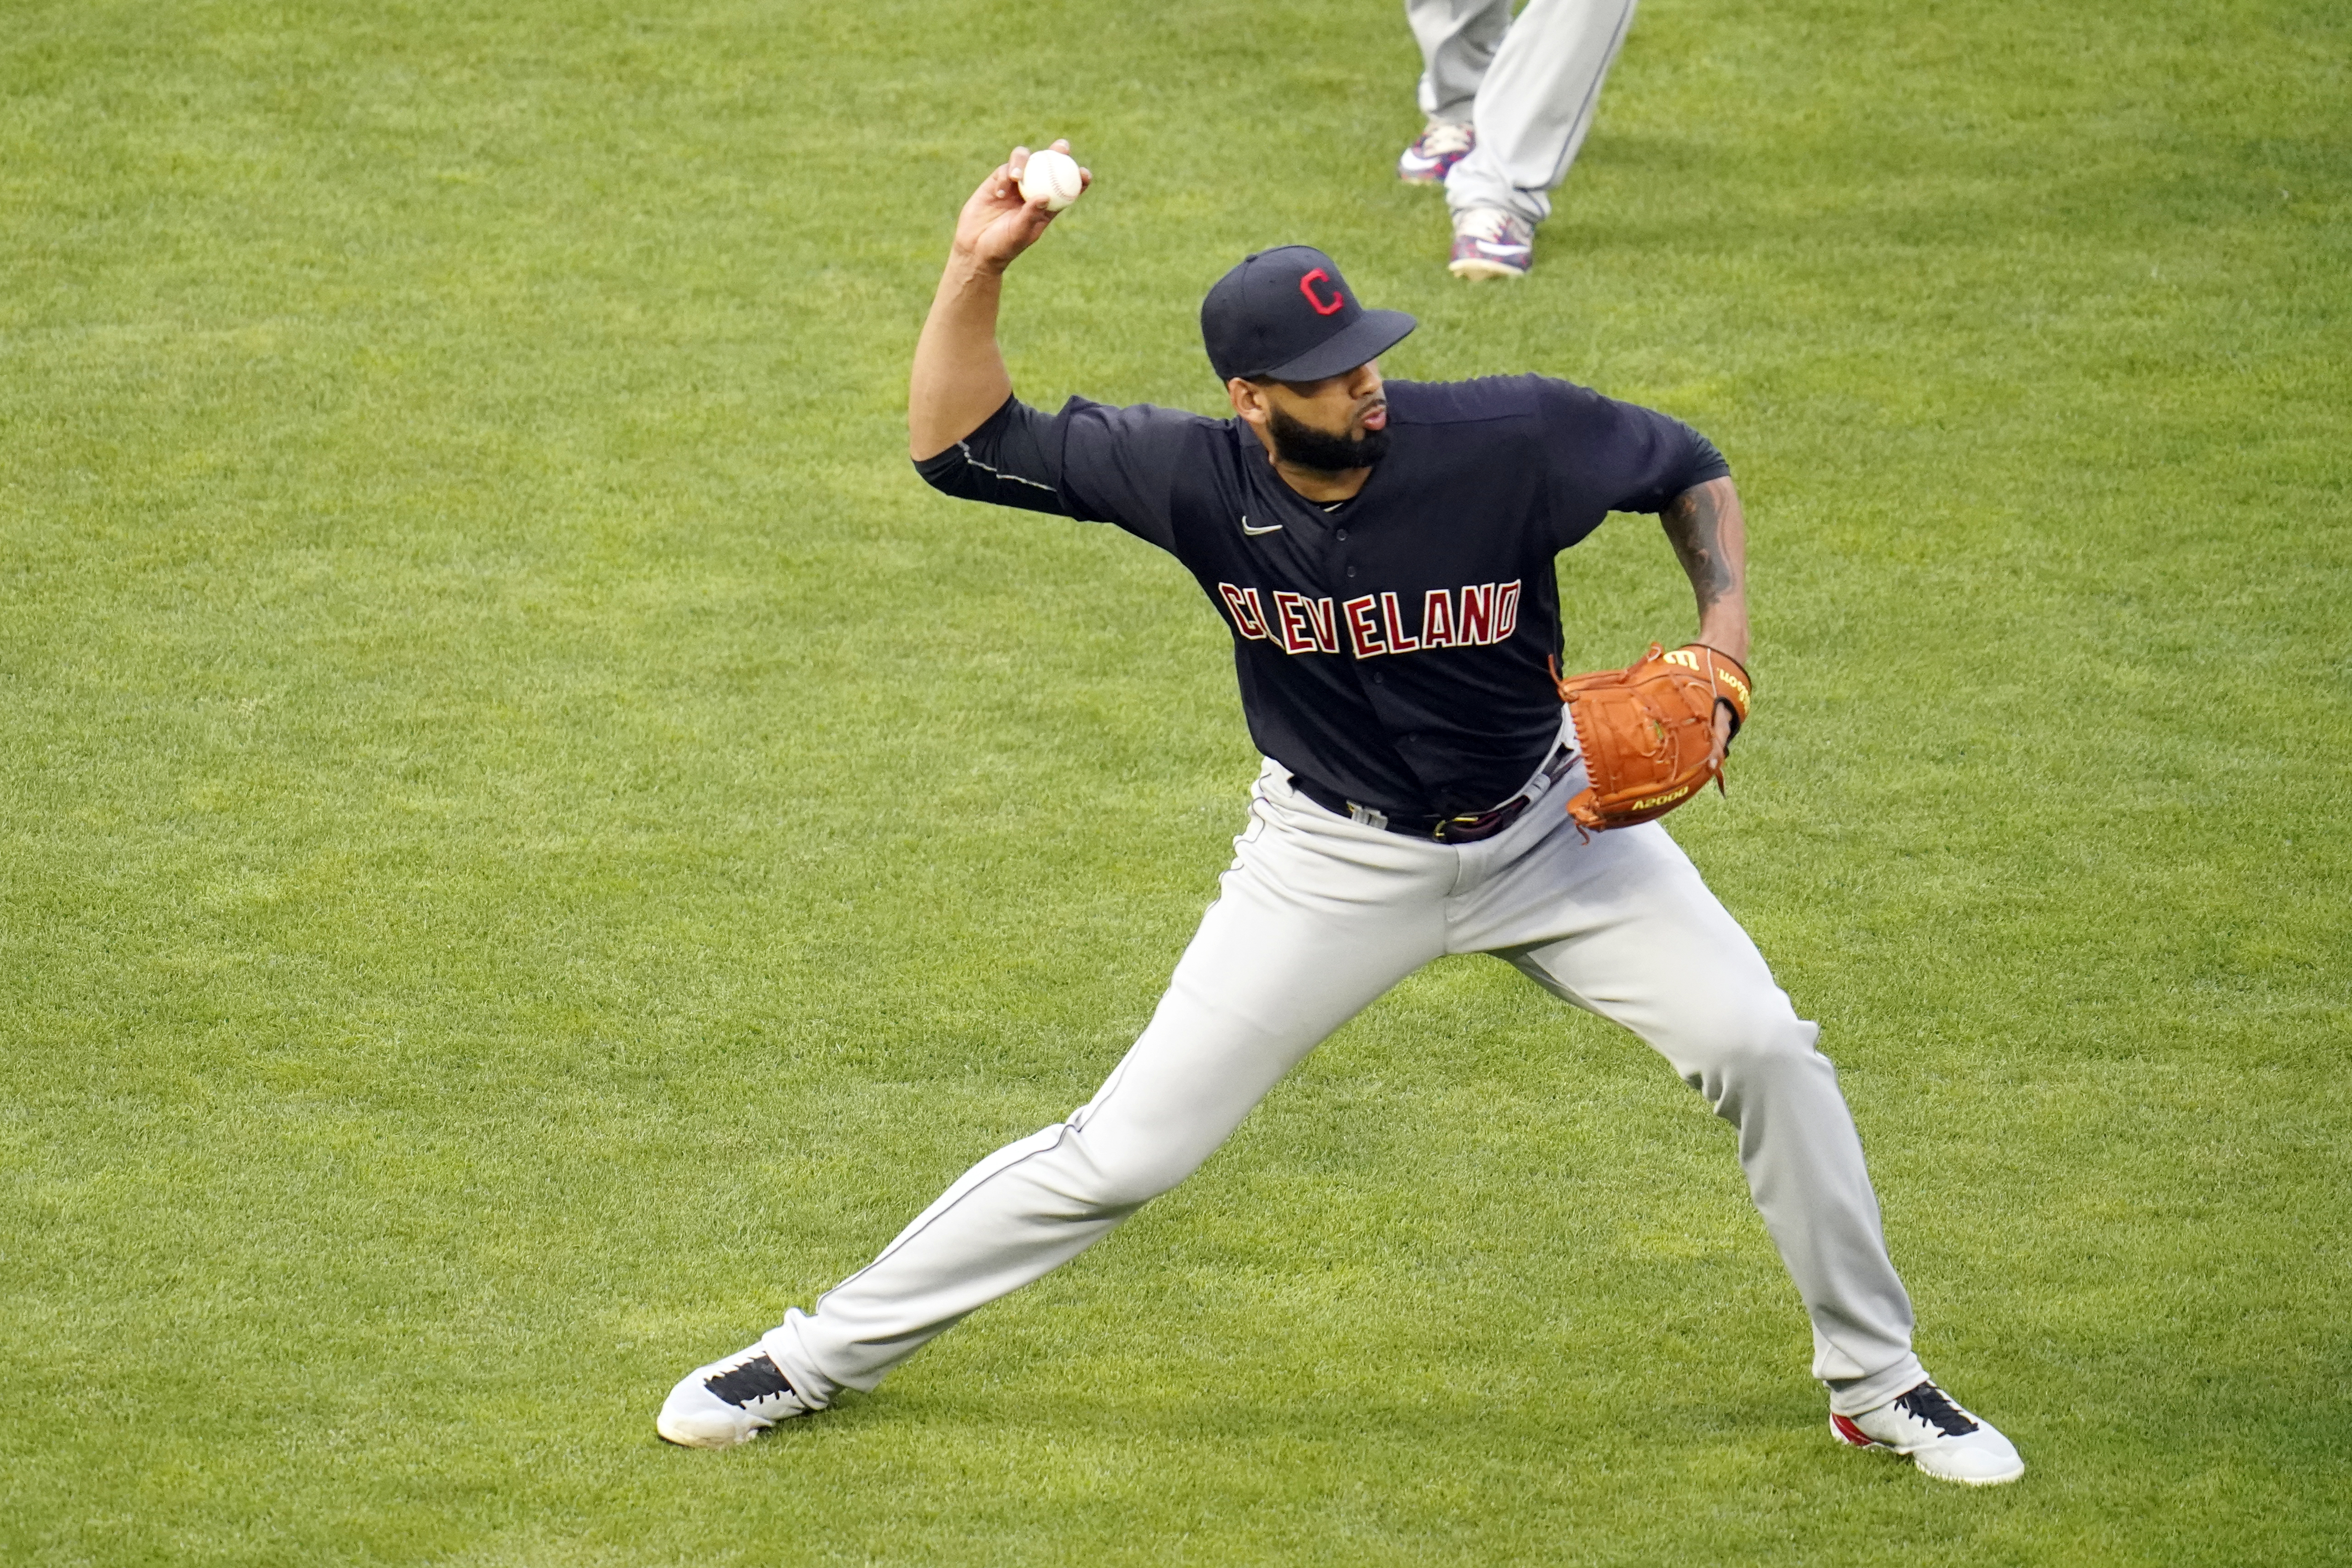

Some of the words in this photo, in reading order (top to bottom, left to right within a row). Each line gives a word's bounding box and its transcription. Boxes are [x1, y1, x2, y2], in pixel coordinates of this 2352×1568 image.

[1300, 268, 1344, 315] C
[1219, 579, 1521, 659] CLEVELAND
[1632, 786, 1688, 811] A2000
